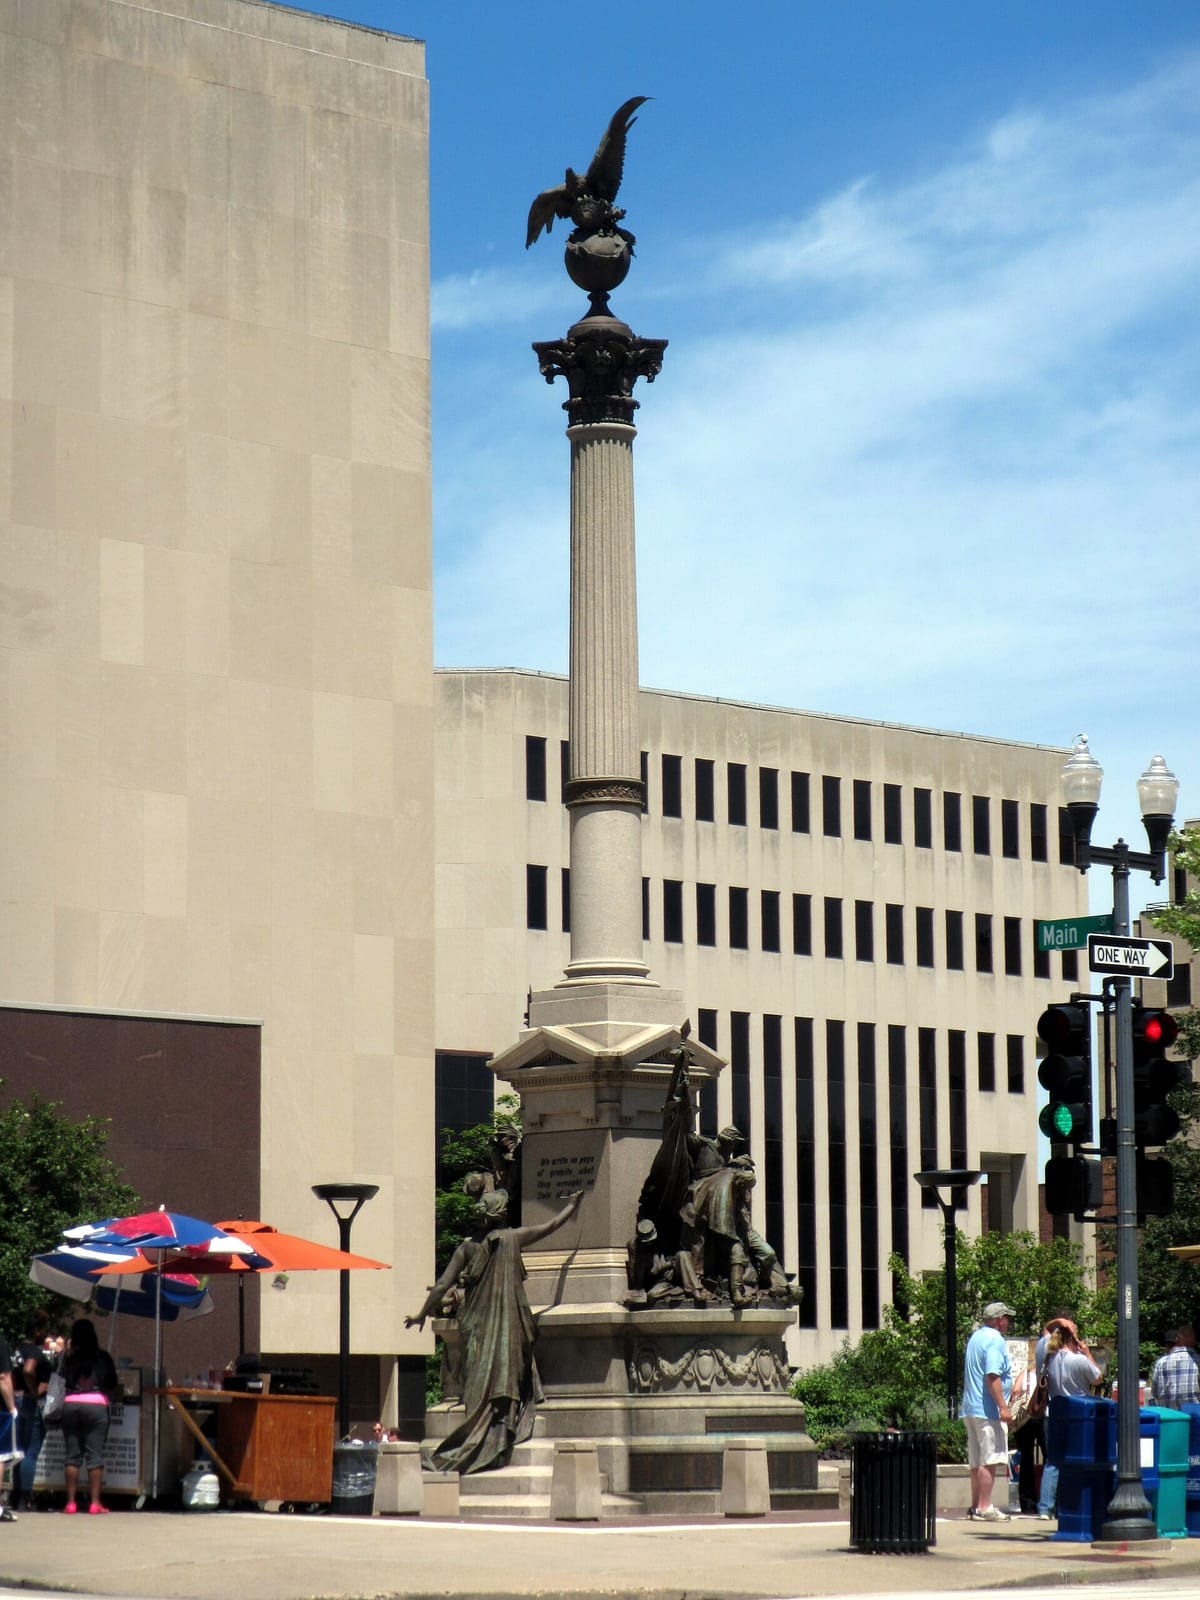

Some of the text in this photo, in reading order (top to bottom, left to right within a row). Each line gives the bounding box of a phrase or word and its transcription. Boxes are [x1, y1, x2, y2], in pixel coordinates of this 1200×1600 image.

[1043, 924, 1078, 946] Main
[1097, 947, 1147, 965] ONE WAY
